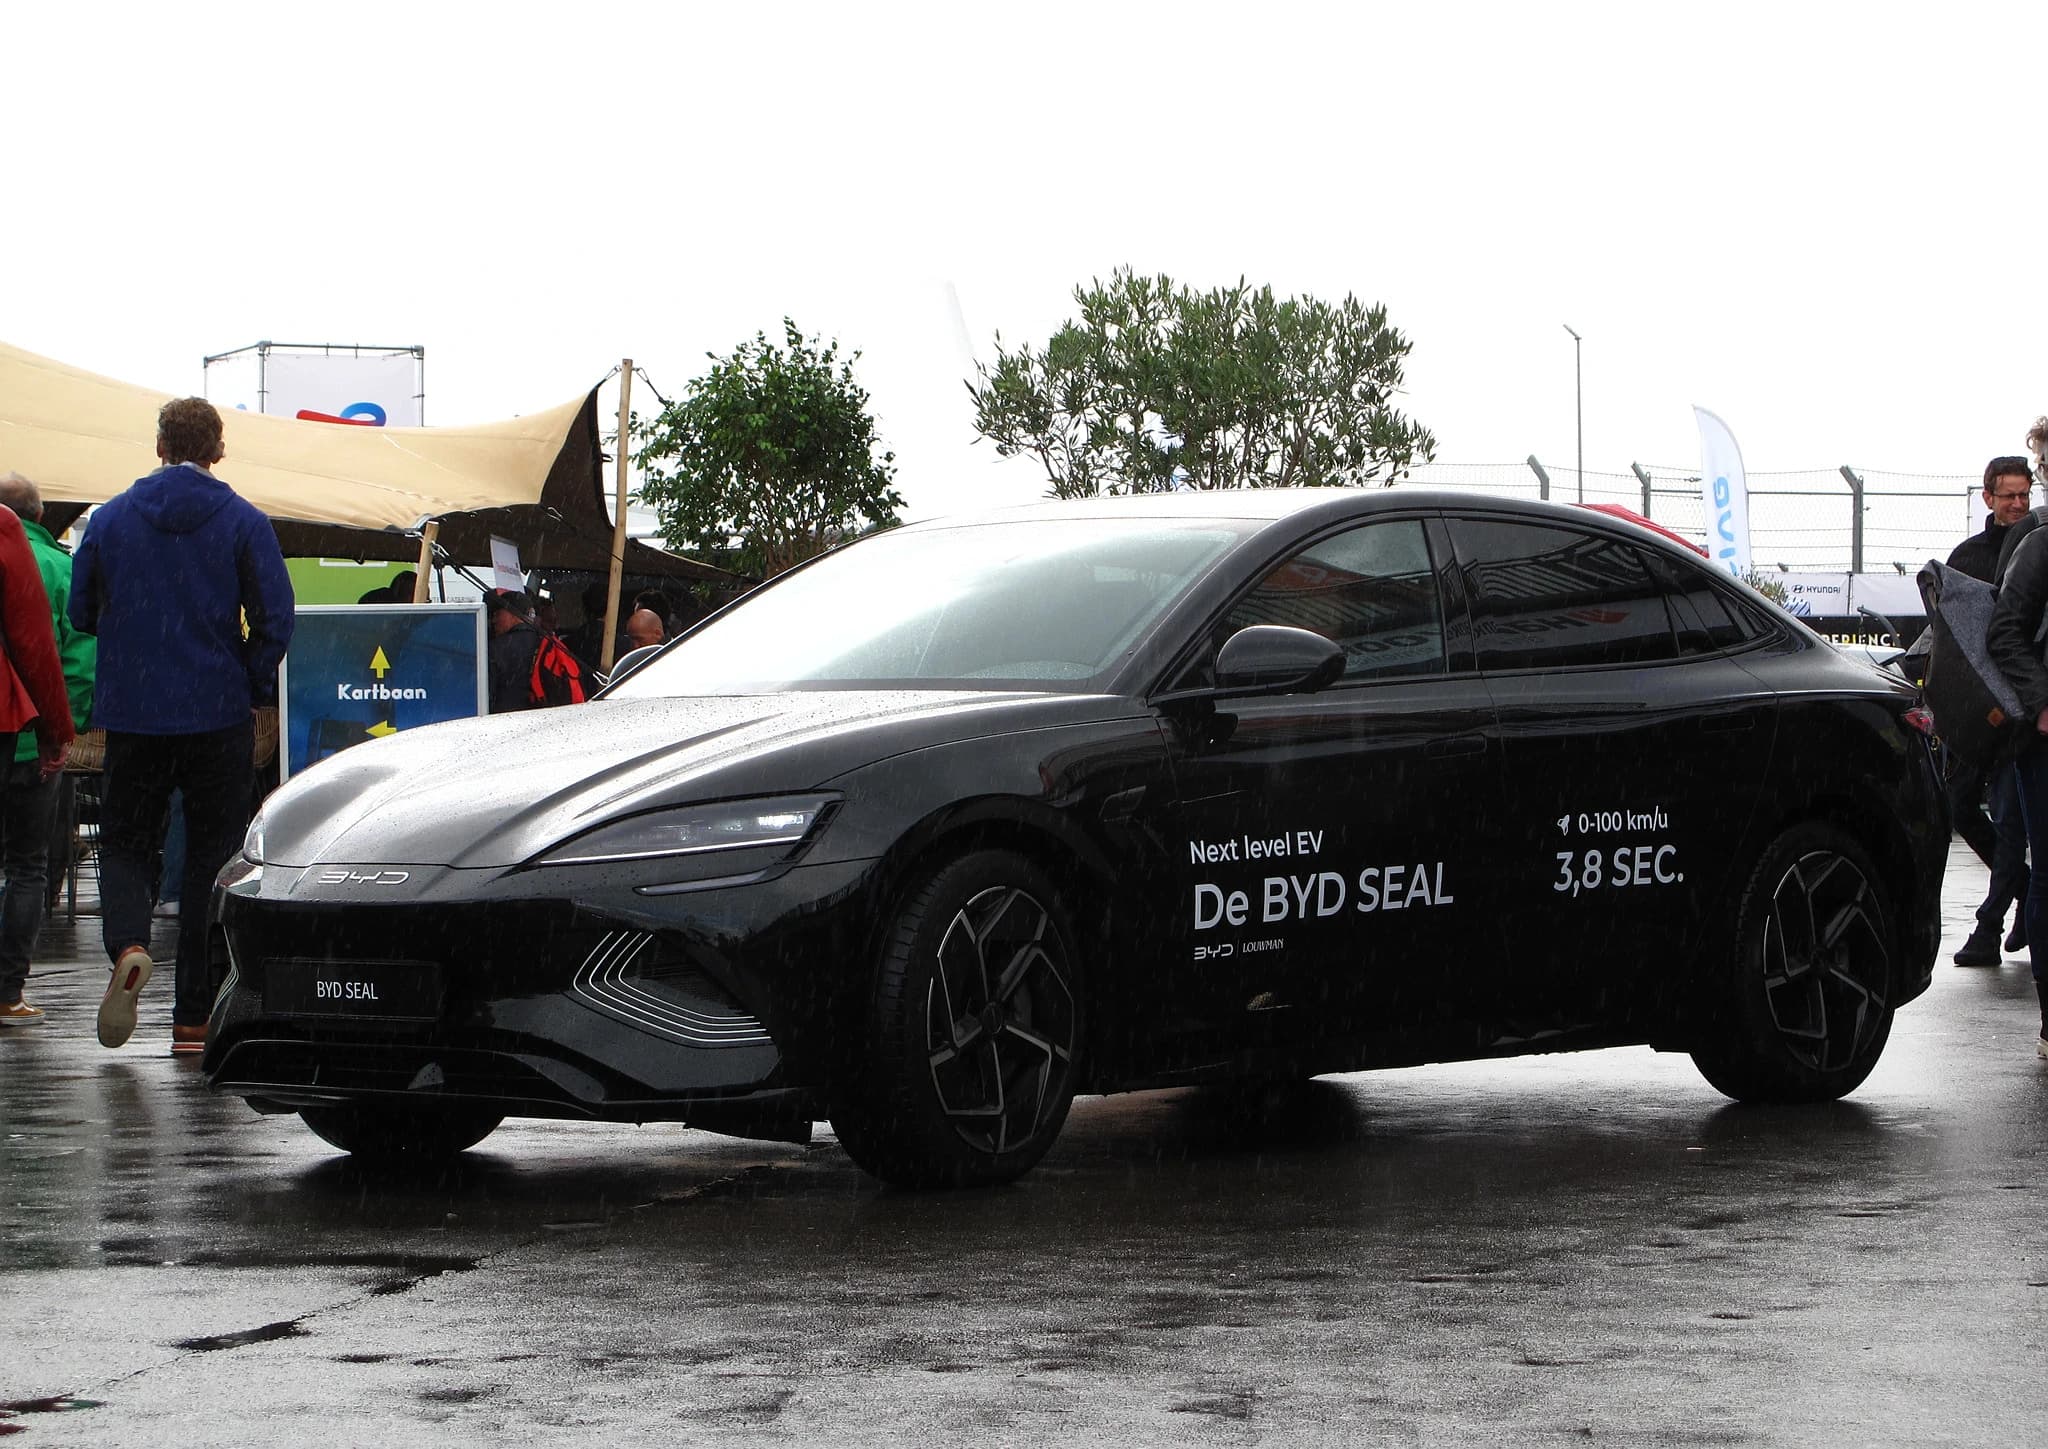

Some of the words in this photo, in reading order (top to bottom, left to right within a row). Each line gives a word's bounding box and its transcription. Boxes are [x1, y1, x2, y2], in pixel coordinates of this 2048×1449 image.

[1806, 585, 1841, 594] HYUNDAI
[337, 683, 427, 700] Kartbaan
[1578, 811, 1622, 834] 0-100
[1626, 805, 1668, 831] km/u
[1190, 839, 1239, 864] Next
[1244, 831, 1291, 860] level
[1297, 830, 1323, 855] EV
[318, 871, 409, 884] BYD
[1553, 849, 1603, 898] 3,8
[1611, 844, 1684, 887] SEC.
[1194, 883, 1249, 930] De
[1262, 871, 1346, 923] BYD
[1357, 861, 1454, 912] SEAL
[1193, 943, 1234, 960] BYD
[1242, 938, 1285, 953] LOUWMAN
[316, 981, 342, 998] BYD
[345, 982, 379, 1000] SEAL
